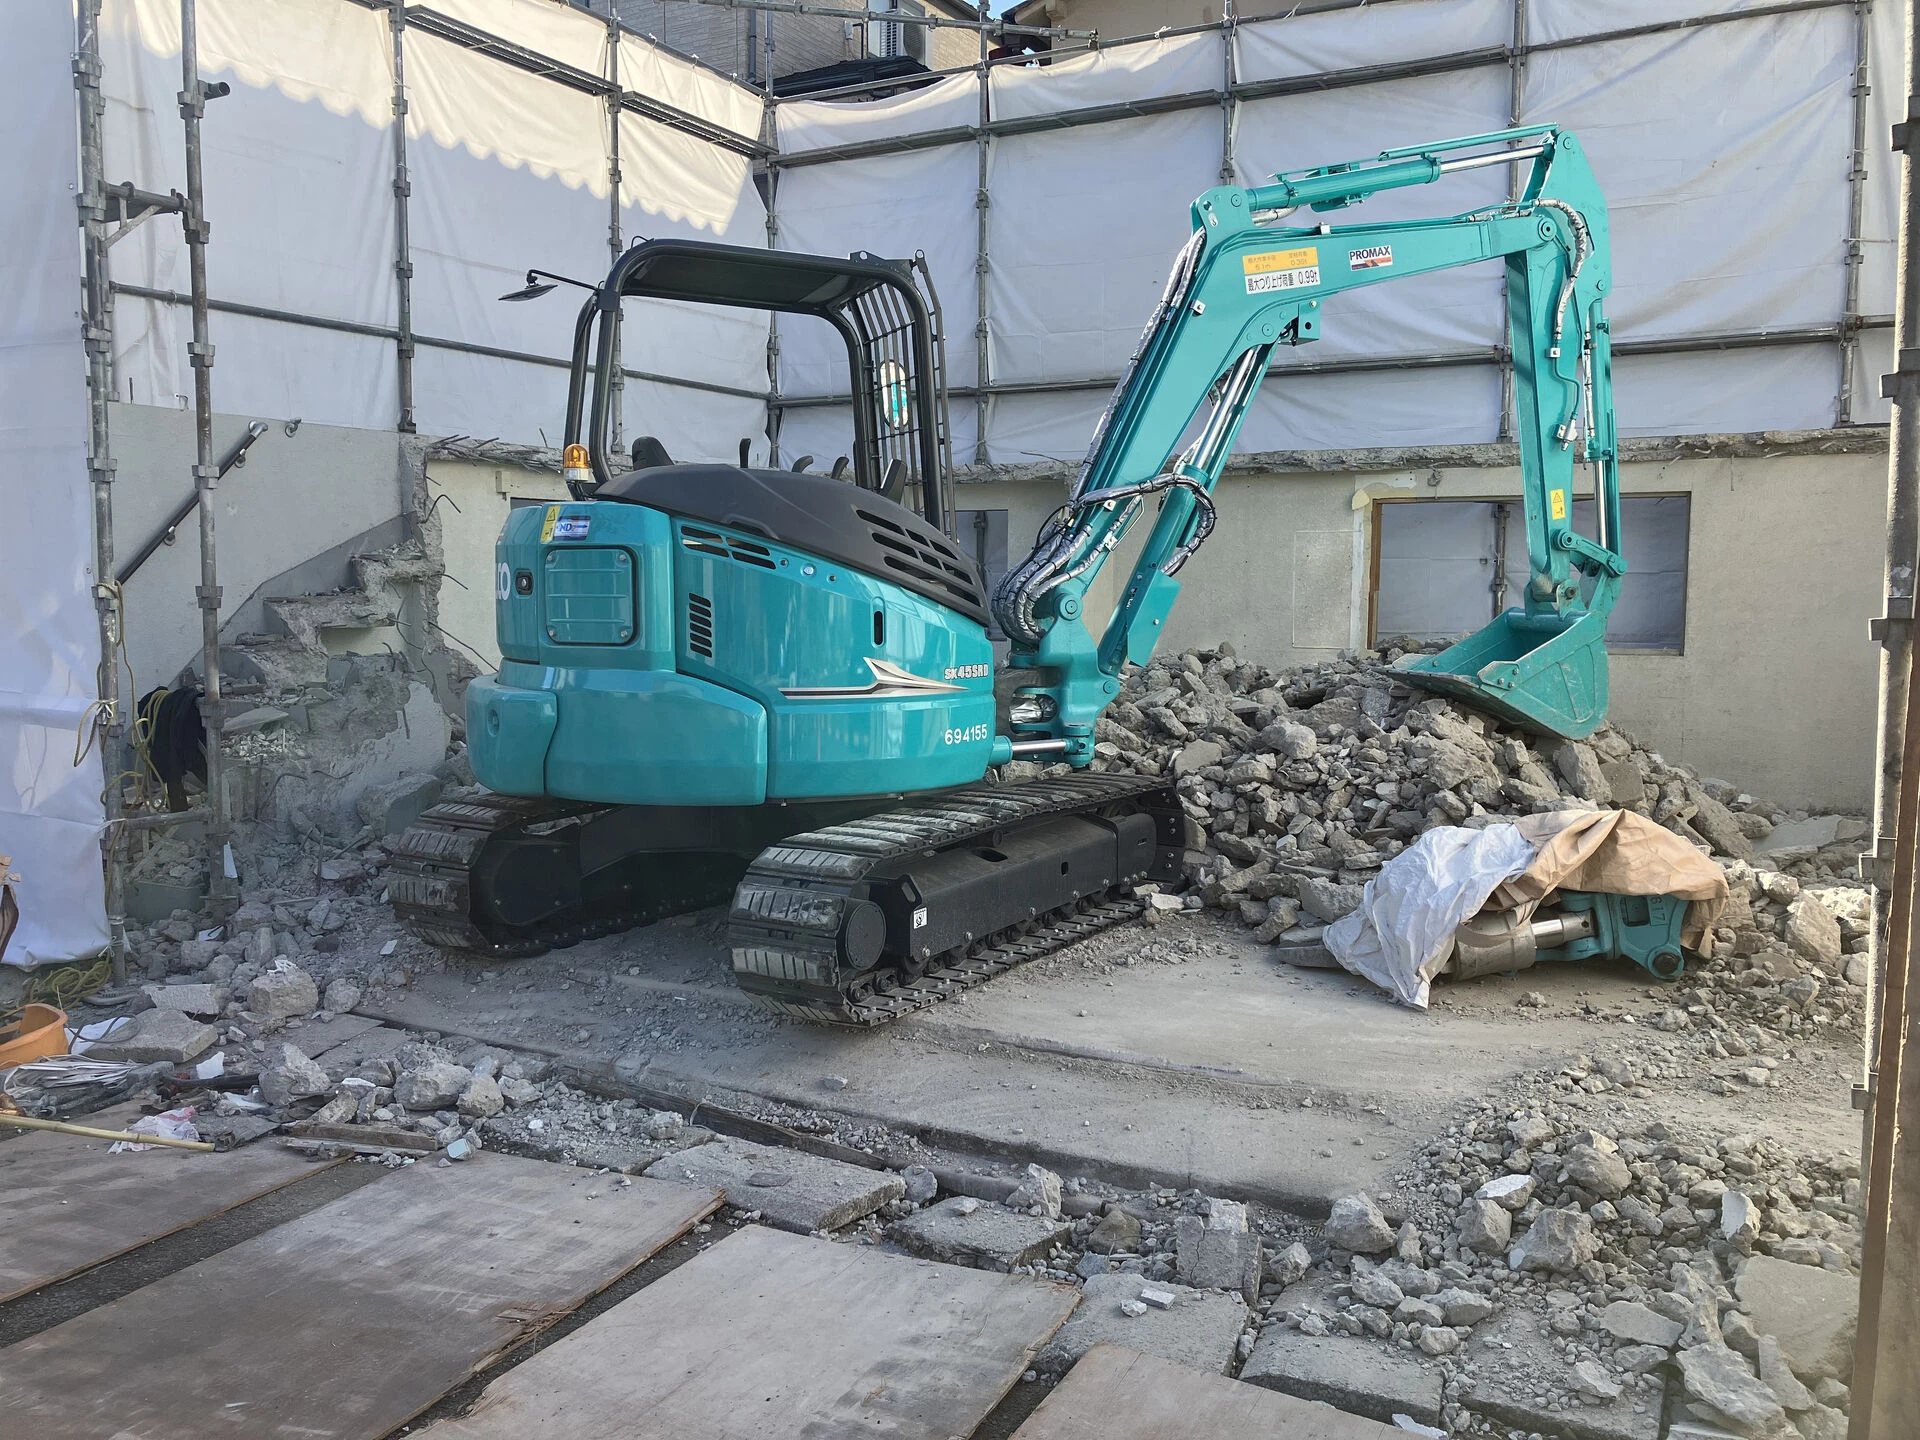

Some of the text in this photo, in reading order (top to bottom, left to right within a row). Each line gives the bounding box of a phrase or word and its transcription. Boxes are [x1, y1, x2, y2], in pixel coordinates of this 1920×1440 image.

[1350, 246, 1390, 260] PROMAX
[944, 664, 989, 680] SK45SRD
[944, 723, 988, 745] 694155
